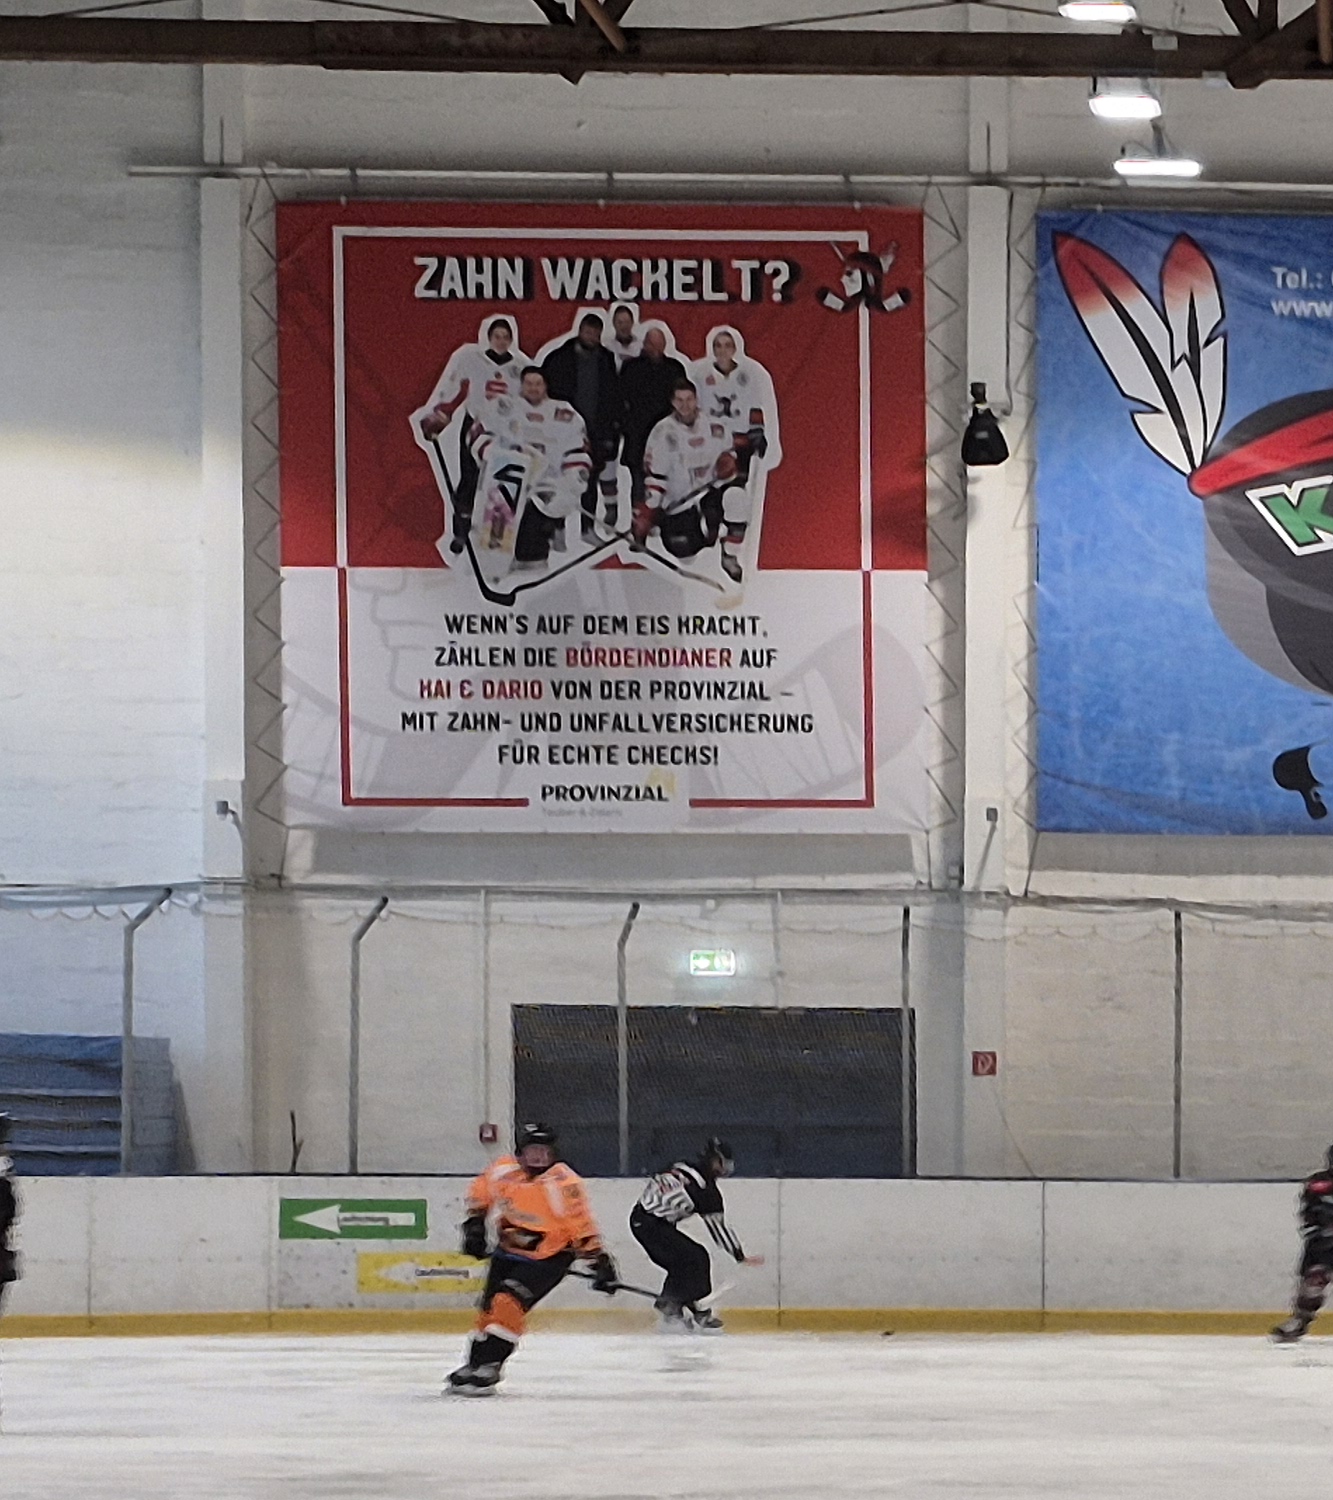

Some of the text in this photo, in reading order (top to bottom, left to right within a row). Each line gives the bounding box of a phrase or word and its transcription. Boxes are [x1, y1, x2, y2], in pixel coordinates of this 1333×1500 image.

[414, 257, 524, 299] ZAHN
[1271, 267, 1323, 289] Tel.:
[444, 613, 529, 635] WENN'S
[536, 614, 575, 635] AUF
[583, 615, 628, 636] DEM
[636, 615, 670, 636] EIS
[434, 641, 778, 669] ZÄHLEN DIE BÖRDEINDIANER AUF
[482, 679, 543, 700] DARIO
[550, 680, 592, 700] VON
[600, 680, 641, 701] DER
[650, 680, 771, 701] PROVINZIAL
[401, 711, 814, 734] MIT ZAHN- UND UNFALLVERSICHERUNG
[497, 738, 541, 765] FÜR
[548, 744, 619, 766] ECHTE
[541, 784, 669, 802] PROVINZIAL
